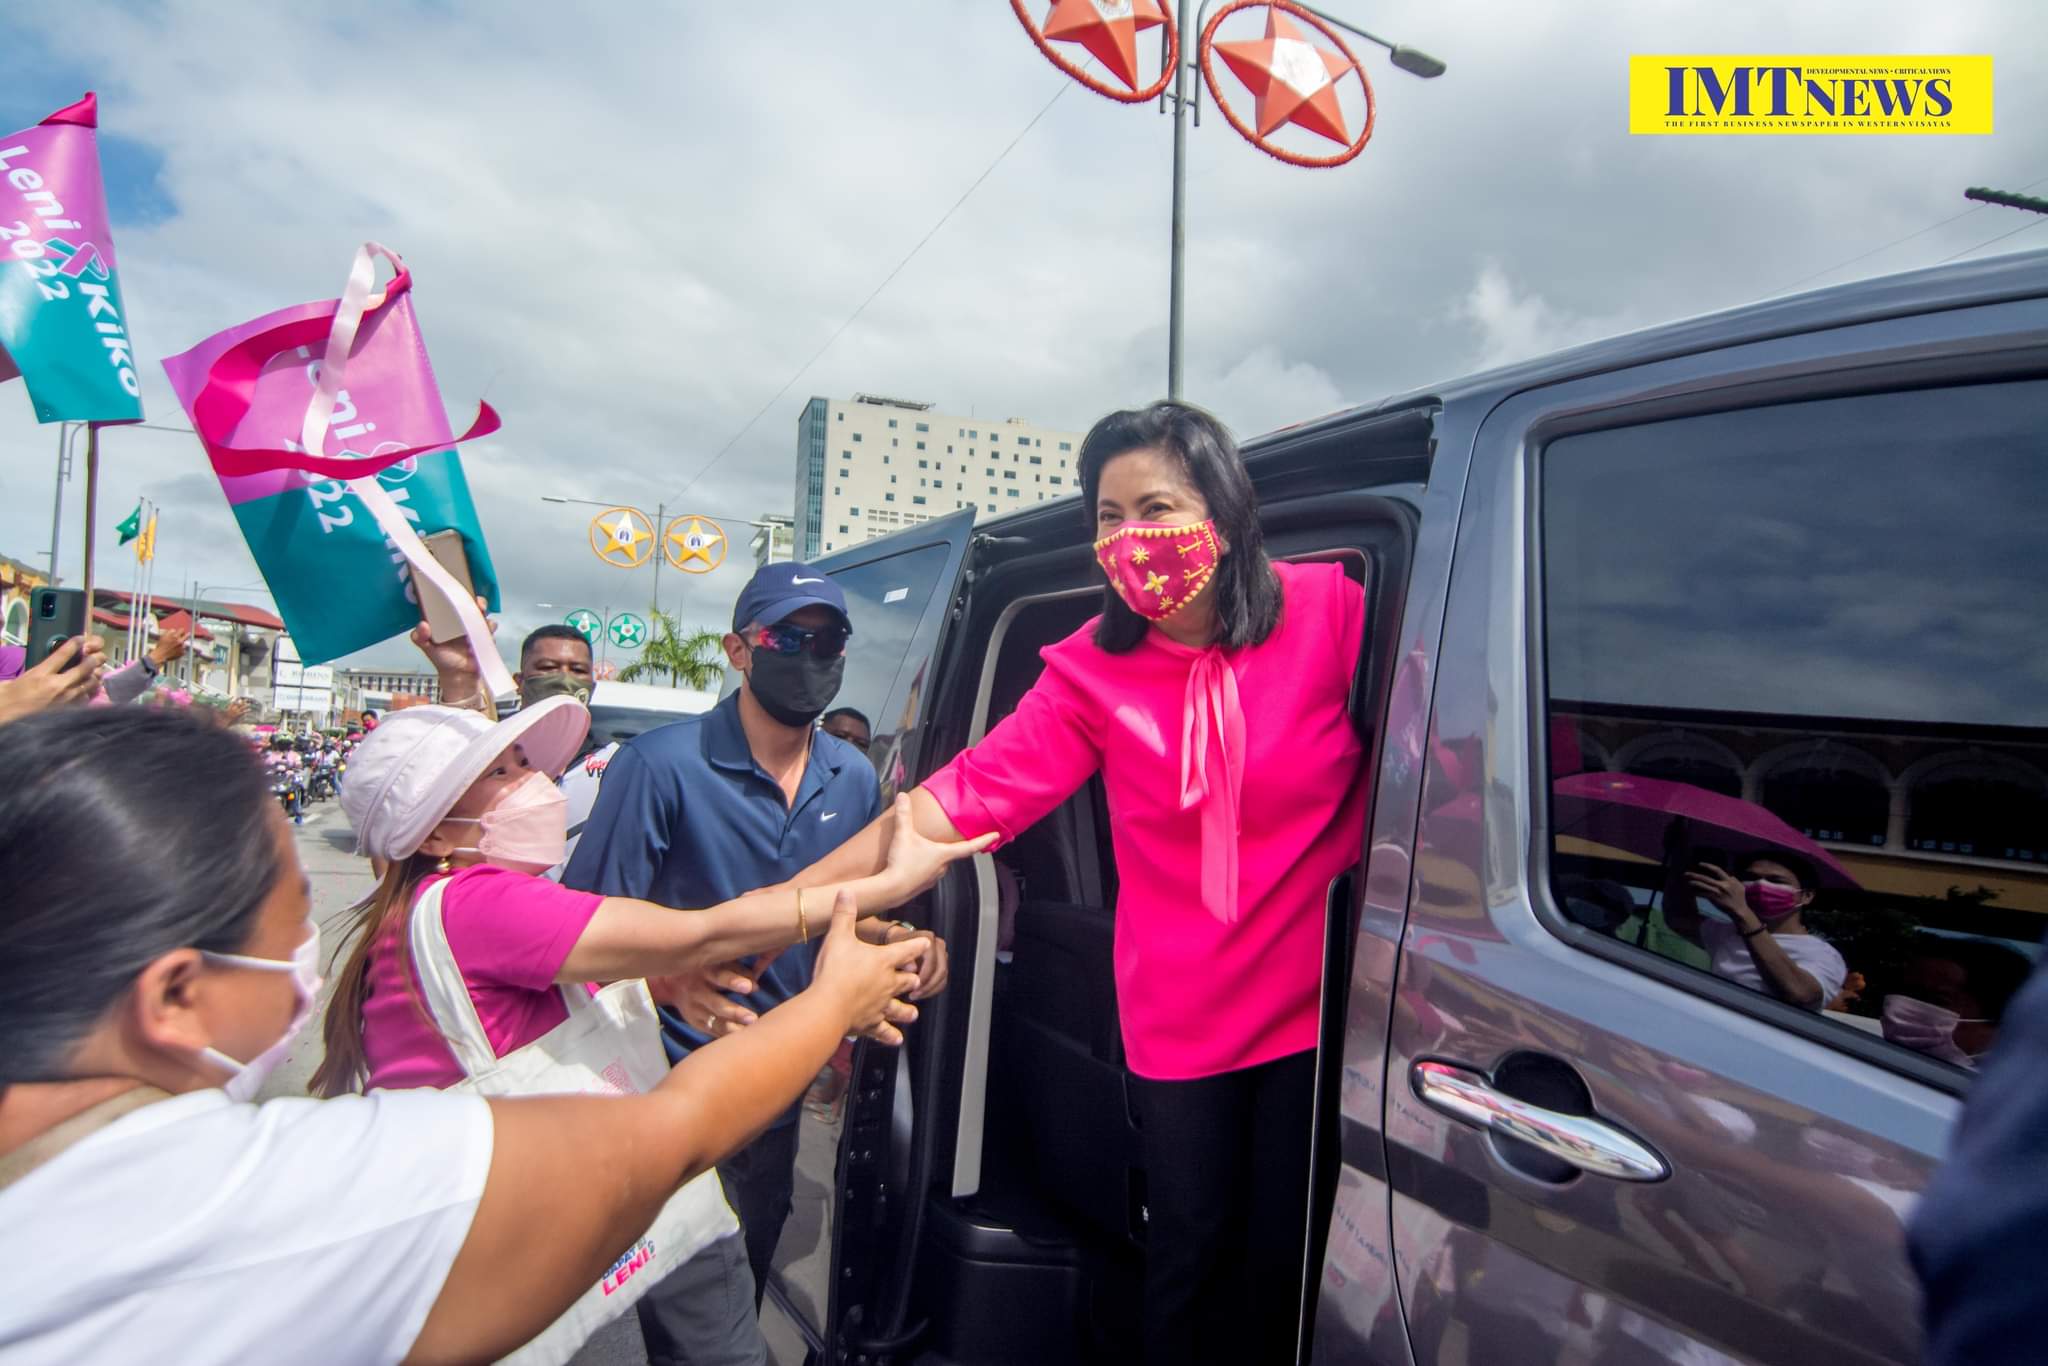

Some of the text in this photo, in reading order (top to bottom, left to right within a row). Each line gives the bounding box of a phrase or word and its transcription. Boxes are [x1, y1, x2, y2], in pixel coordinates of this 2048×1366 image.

[0, 220, 70, 301] 2022
[0, 145, 140, 398] Leni Kiko
[603, 1247, 650, 1296] LENI
